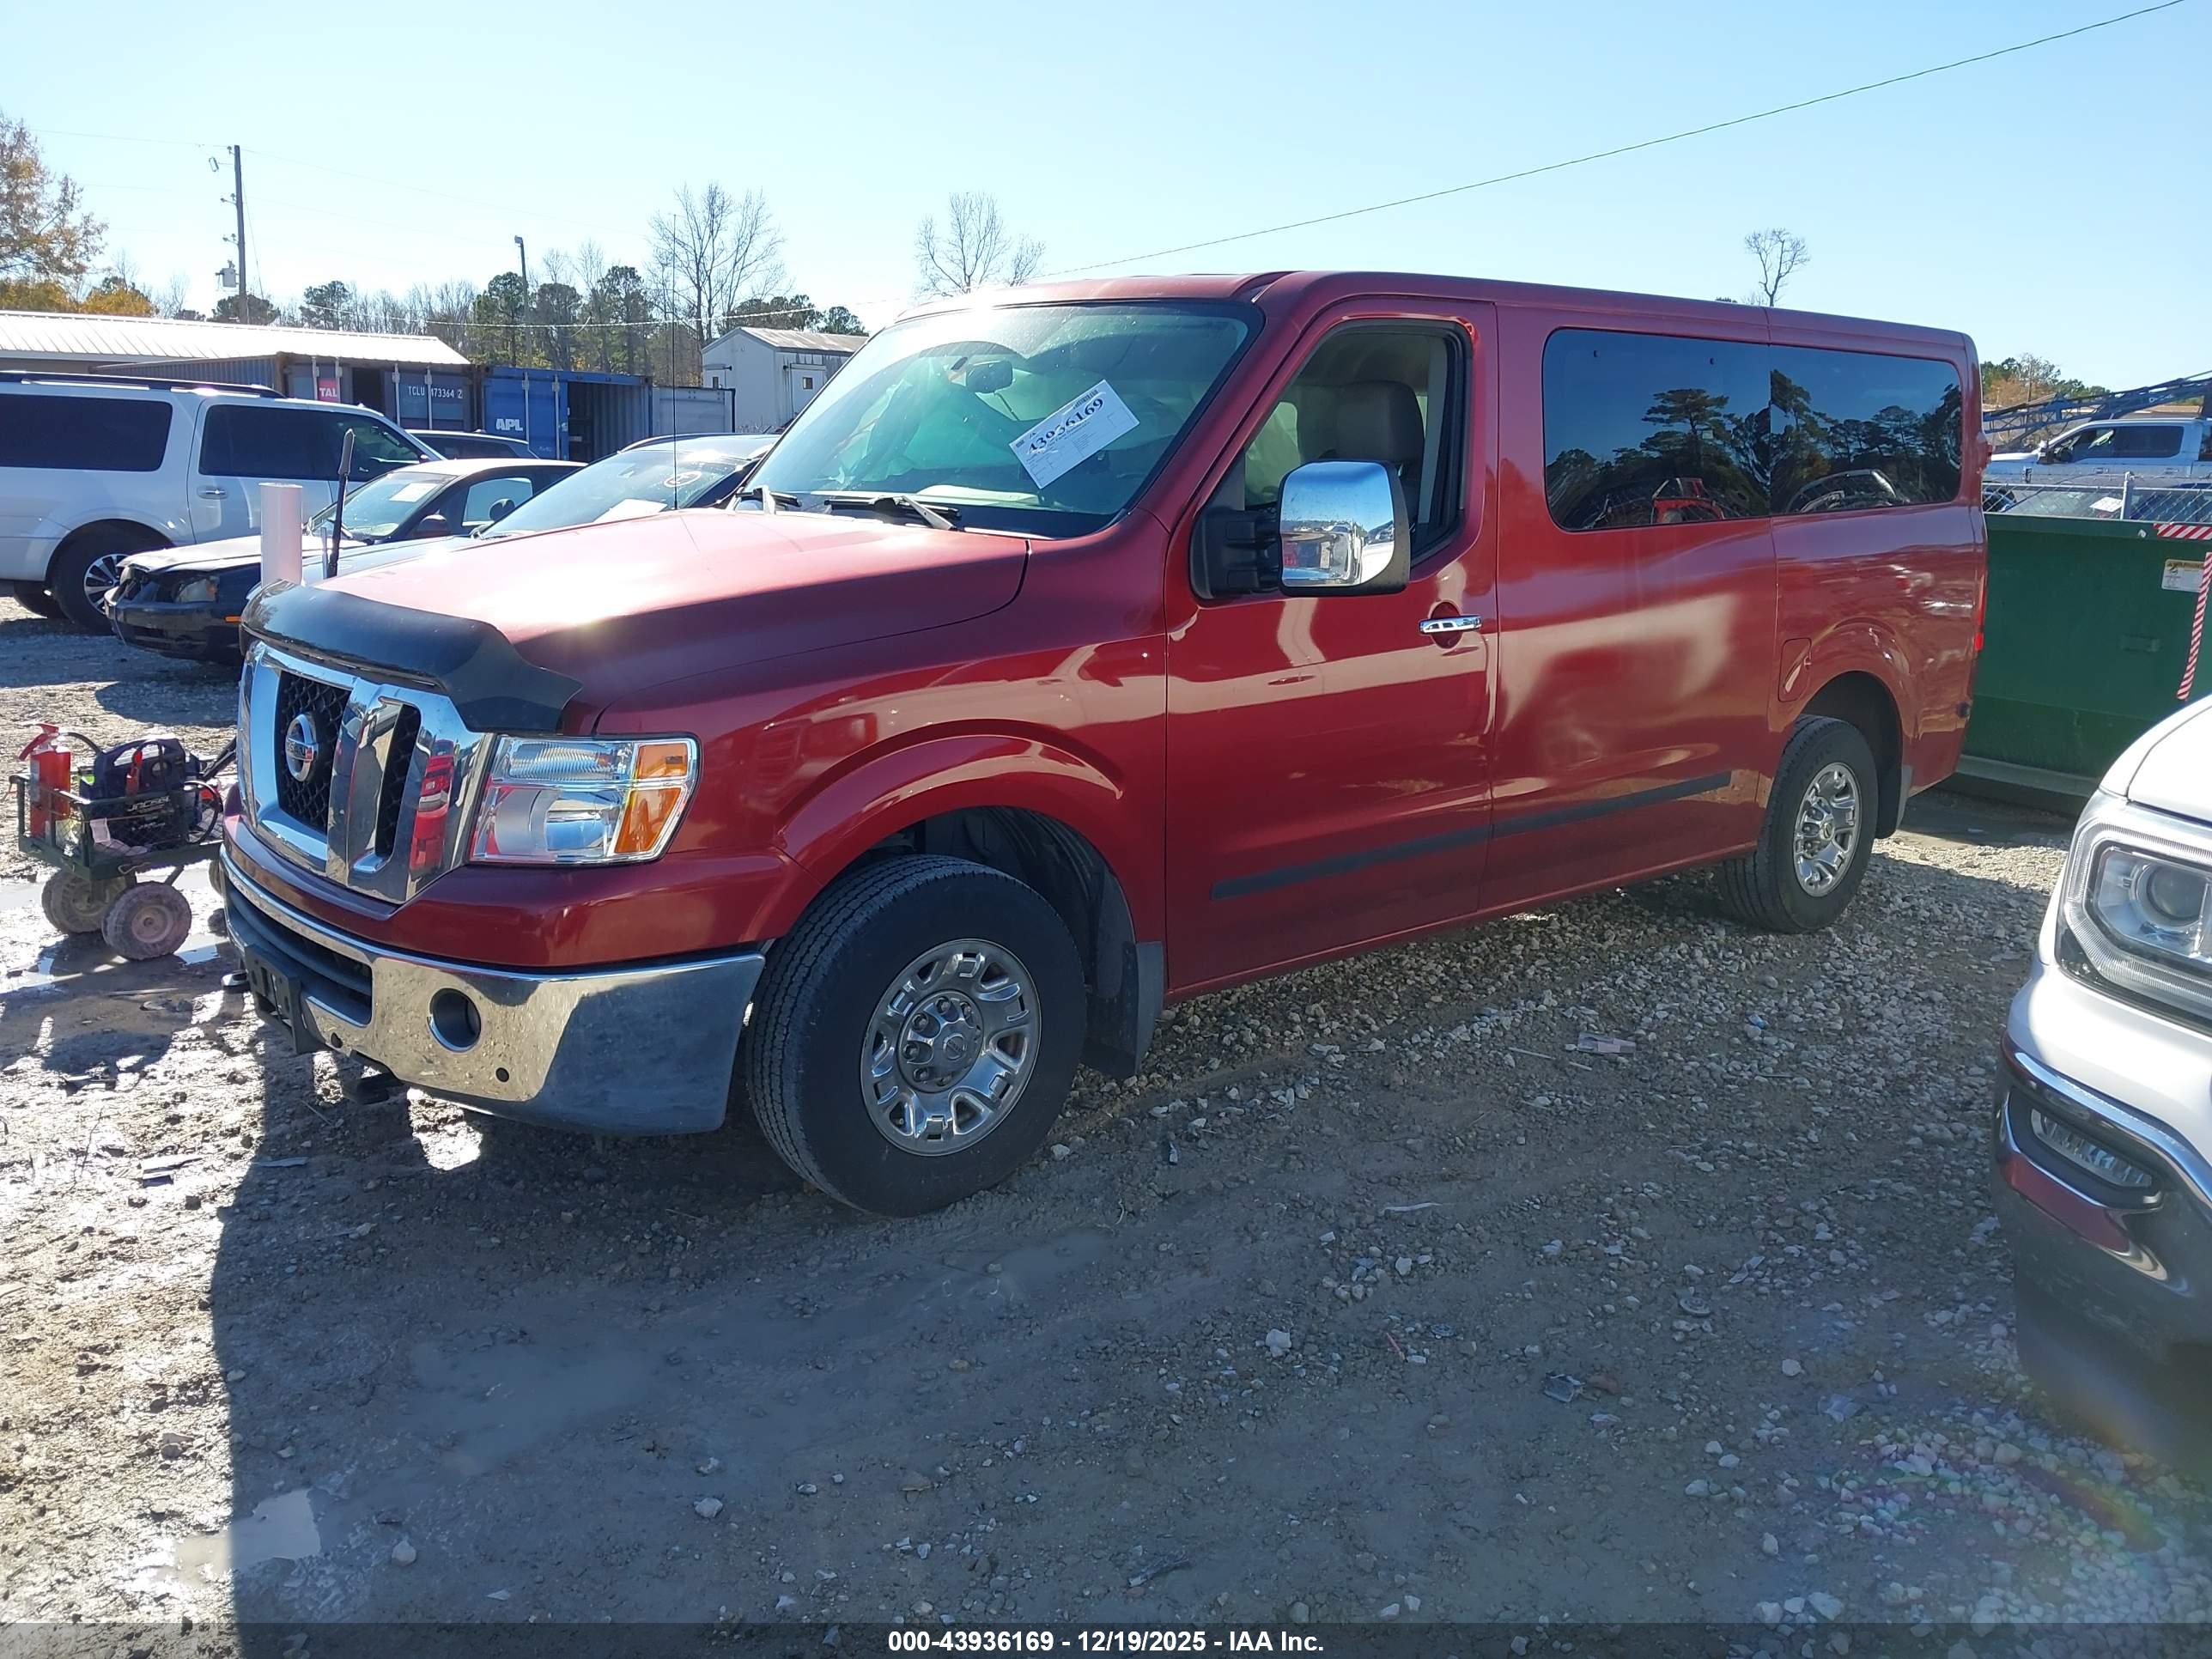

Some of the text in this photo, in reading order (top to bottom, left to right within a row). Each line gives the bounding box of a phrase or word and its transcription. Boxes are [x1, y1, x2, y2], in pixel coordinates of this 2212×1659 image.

[319, 387, 337, 398] TAL
[408, 386, 425, 396] TCLU
[457, 389, 463, 399] 2
[495, 418, 523, 432] APL
